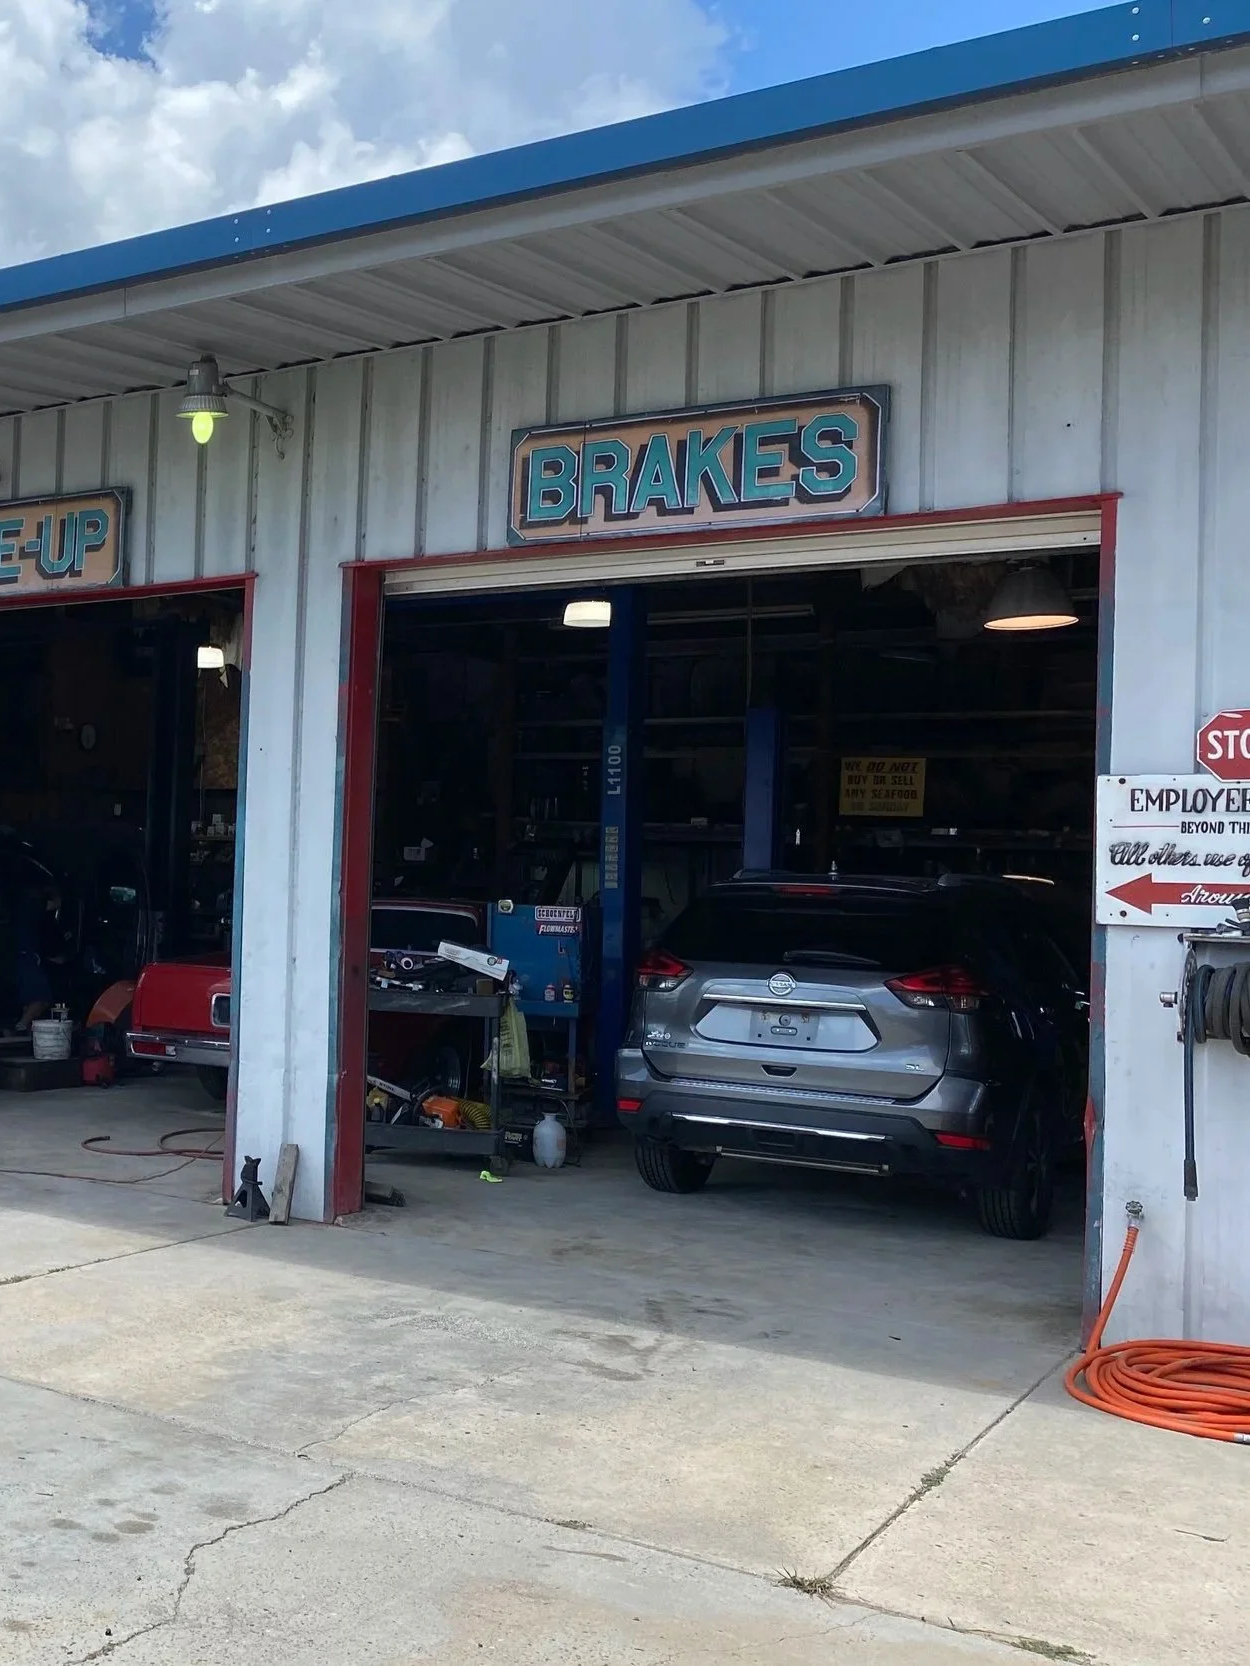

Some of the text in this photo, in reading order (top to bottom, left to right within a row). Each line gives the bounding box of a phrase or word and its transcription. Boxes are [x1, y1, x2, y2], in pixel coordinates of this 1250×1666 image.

[524, 411, 860, 527] BRAKES
[607, 745, 622, 795] L1100
[1180, 821, 1225, 834] BEYOND
[1109, 841, 1149, 866] All
[1148, 842, 1201, 867] others
[1203, 853, 1236, 867] use
